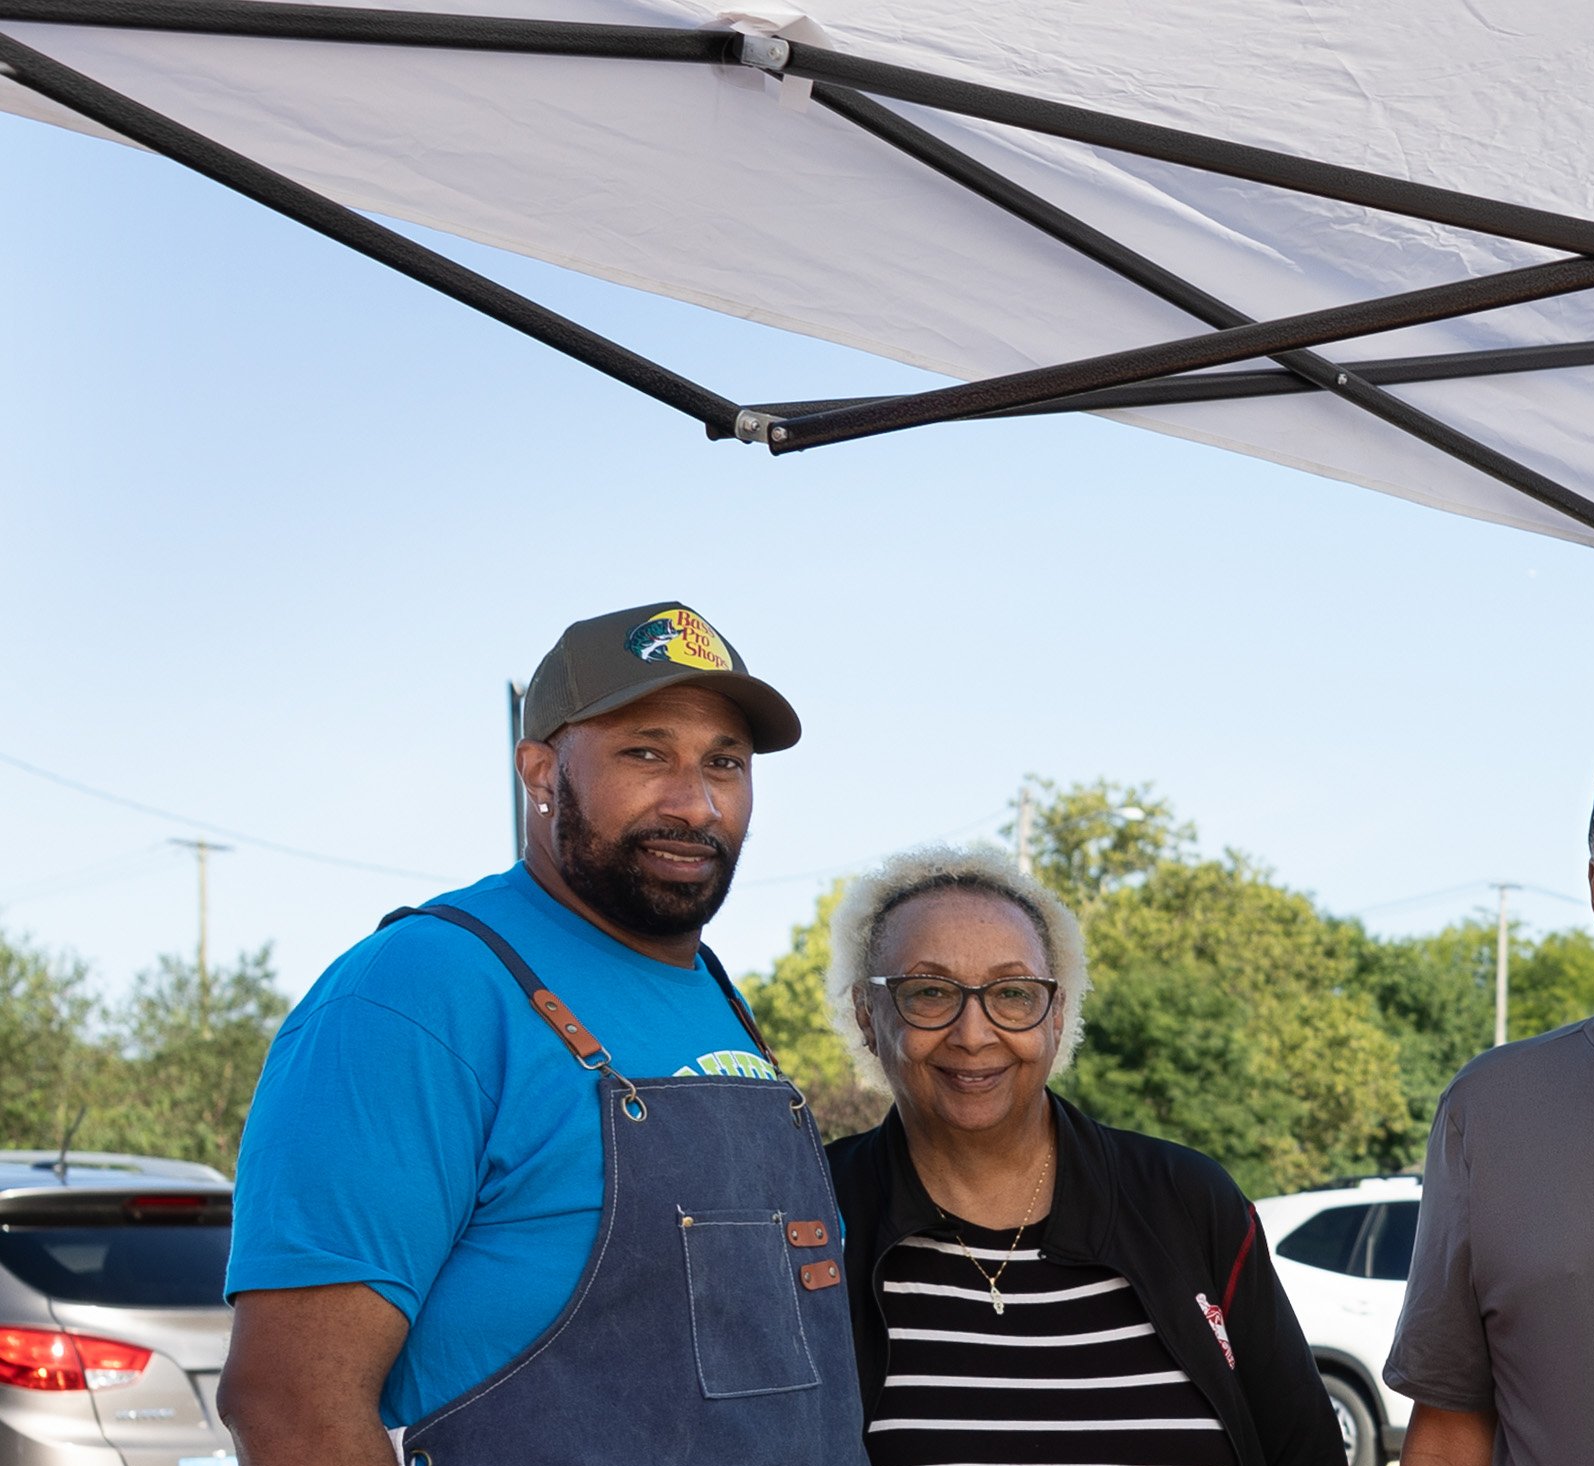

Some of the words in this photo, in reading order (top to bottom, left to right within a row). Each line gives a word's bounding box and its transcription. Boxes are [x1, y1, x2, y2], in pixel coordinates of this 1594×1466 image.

[677, 610, 715, 638] Bass
[682, 627, 710, 647] Pro
[684, 642, 730, 669] Shops
